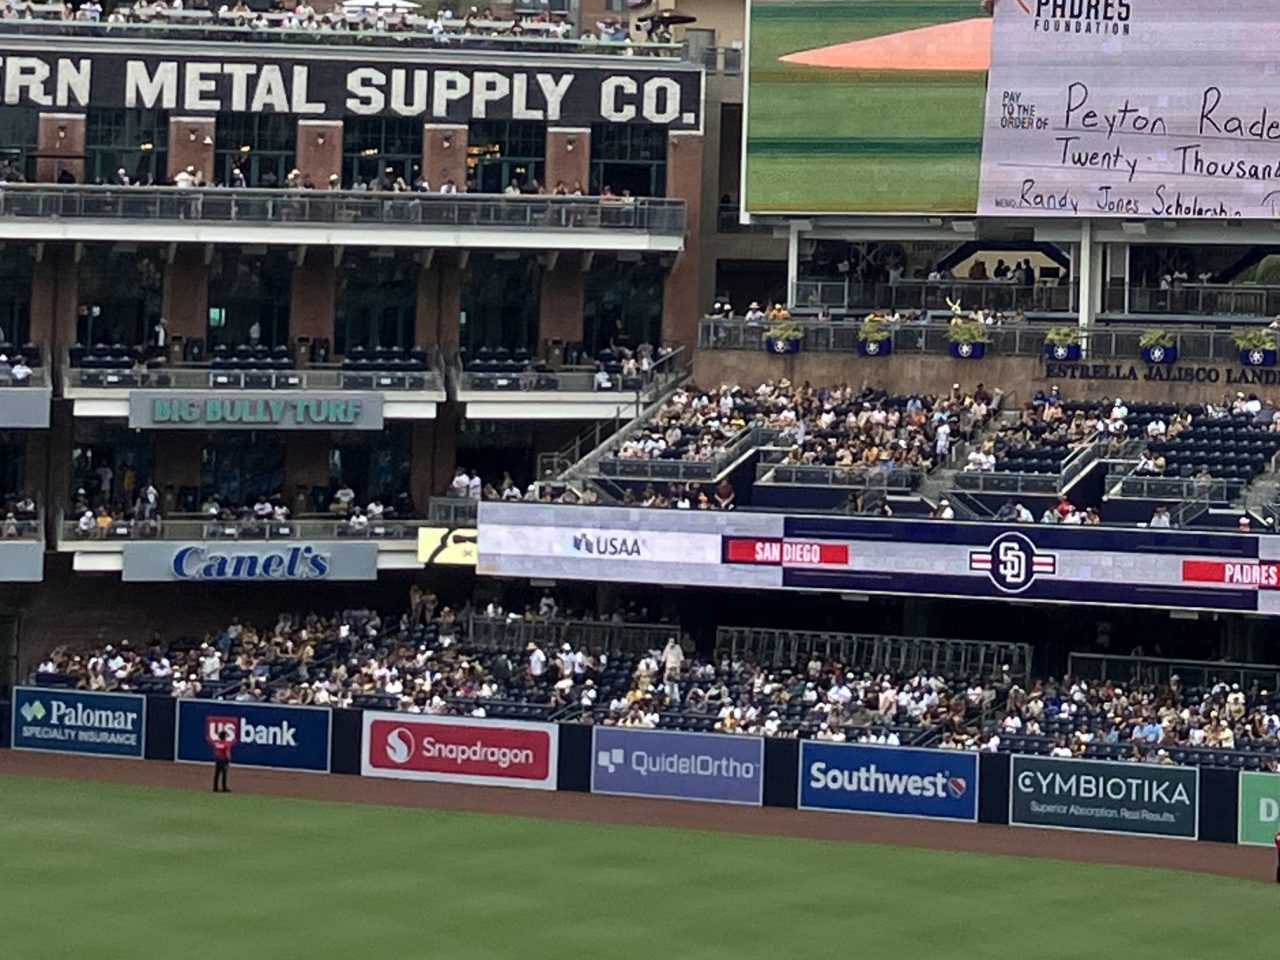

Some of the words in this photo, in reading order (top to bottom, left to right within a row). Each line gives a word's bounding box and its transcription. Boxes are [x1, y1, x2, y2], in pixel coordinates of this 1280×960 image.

[1034, 19, 1130, 35] FOUNDATION
[0, 56, 91, 107] RN
[125, 60, 326, 114] METAL
[345, 67, 575, 121] SUPPLY
[600, 77, 695, 124] CO.
[1003, 91, 1021, 103] PAY
[1001, 116, 1034, 129] ORDER
[1036, 118, 1049, 129] OF
[1002, 104, 1014, 116] TO
[1017, 104, 1035, 117] THE
[1064, 82, 1167, 139] Peyton
[1055, 136, 1138, 183] Twenty
[1020, 179, 1078, 215] Randy
[1096, 186, 1139, 215] Jones
[1045, 363, 1138, 381] ESTRELLA
[1144, 365, 1220, 383] JALISCO
[154, 398, 200, 423] BIG
[205, 398, 285, 424] BULLY
[293, 398, 361, 424] TURF
[596, 536, 641, 557] USAA
[755, 542, 780, 561] SAN
[783, 543, 820, 562] DIEGO
[172, 546, 332, 578] Canel's
[1224, 563, 1278, 586] PADRES
[50, 701, 137, 730] Palomar
[22, 726, 76, 740] SPECIALTY
[78, 730, 137, 746] INSURANCE
[240, 717, 298, 746] bank
[422, 737, 533, 768] Snapdragon
[632, 750, 754, 779] QuidelOrtho
[810, 759, 946, 798] Southwest
[1018, 771, 1190, 805] CYMBIOTIKA
[1030, 800, 1068, 814] Superior
